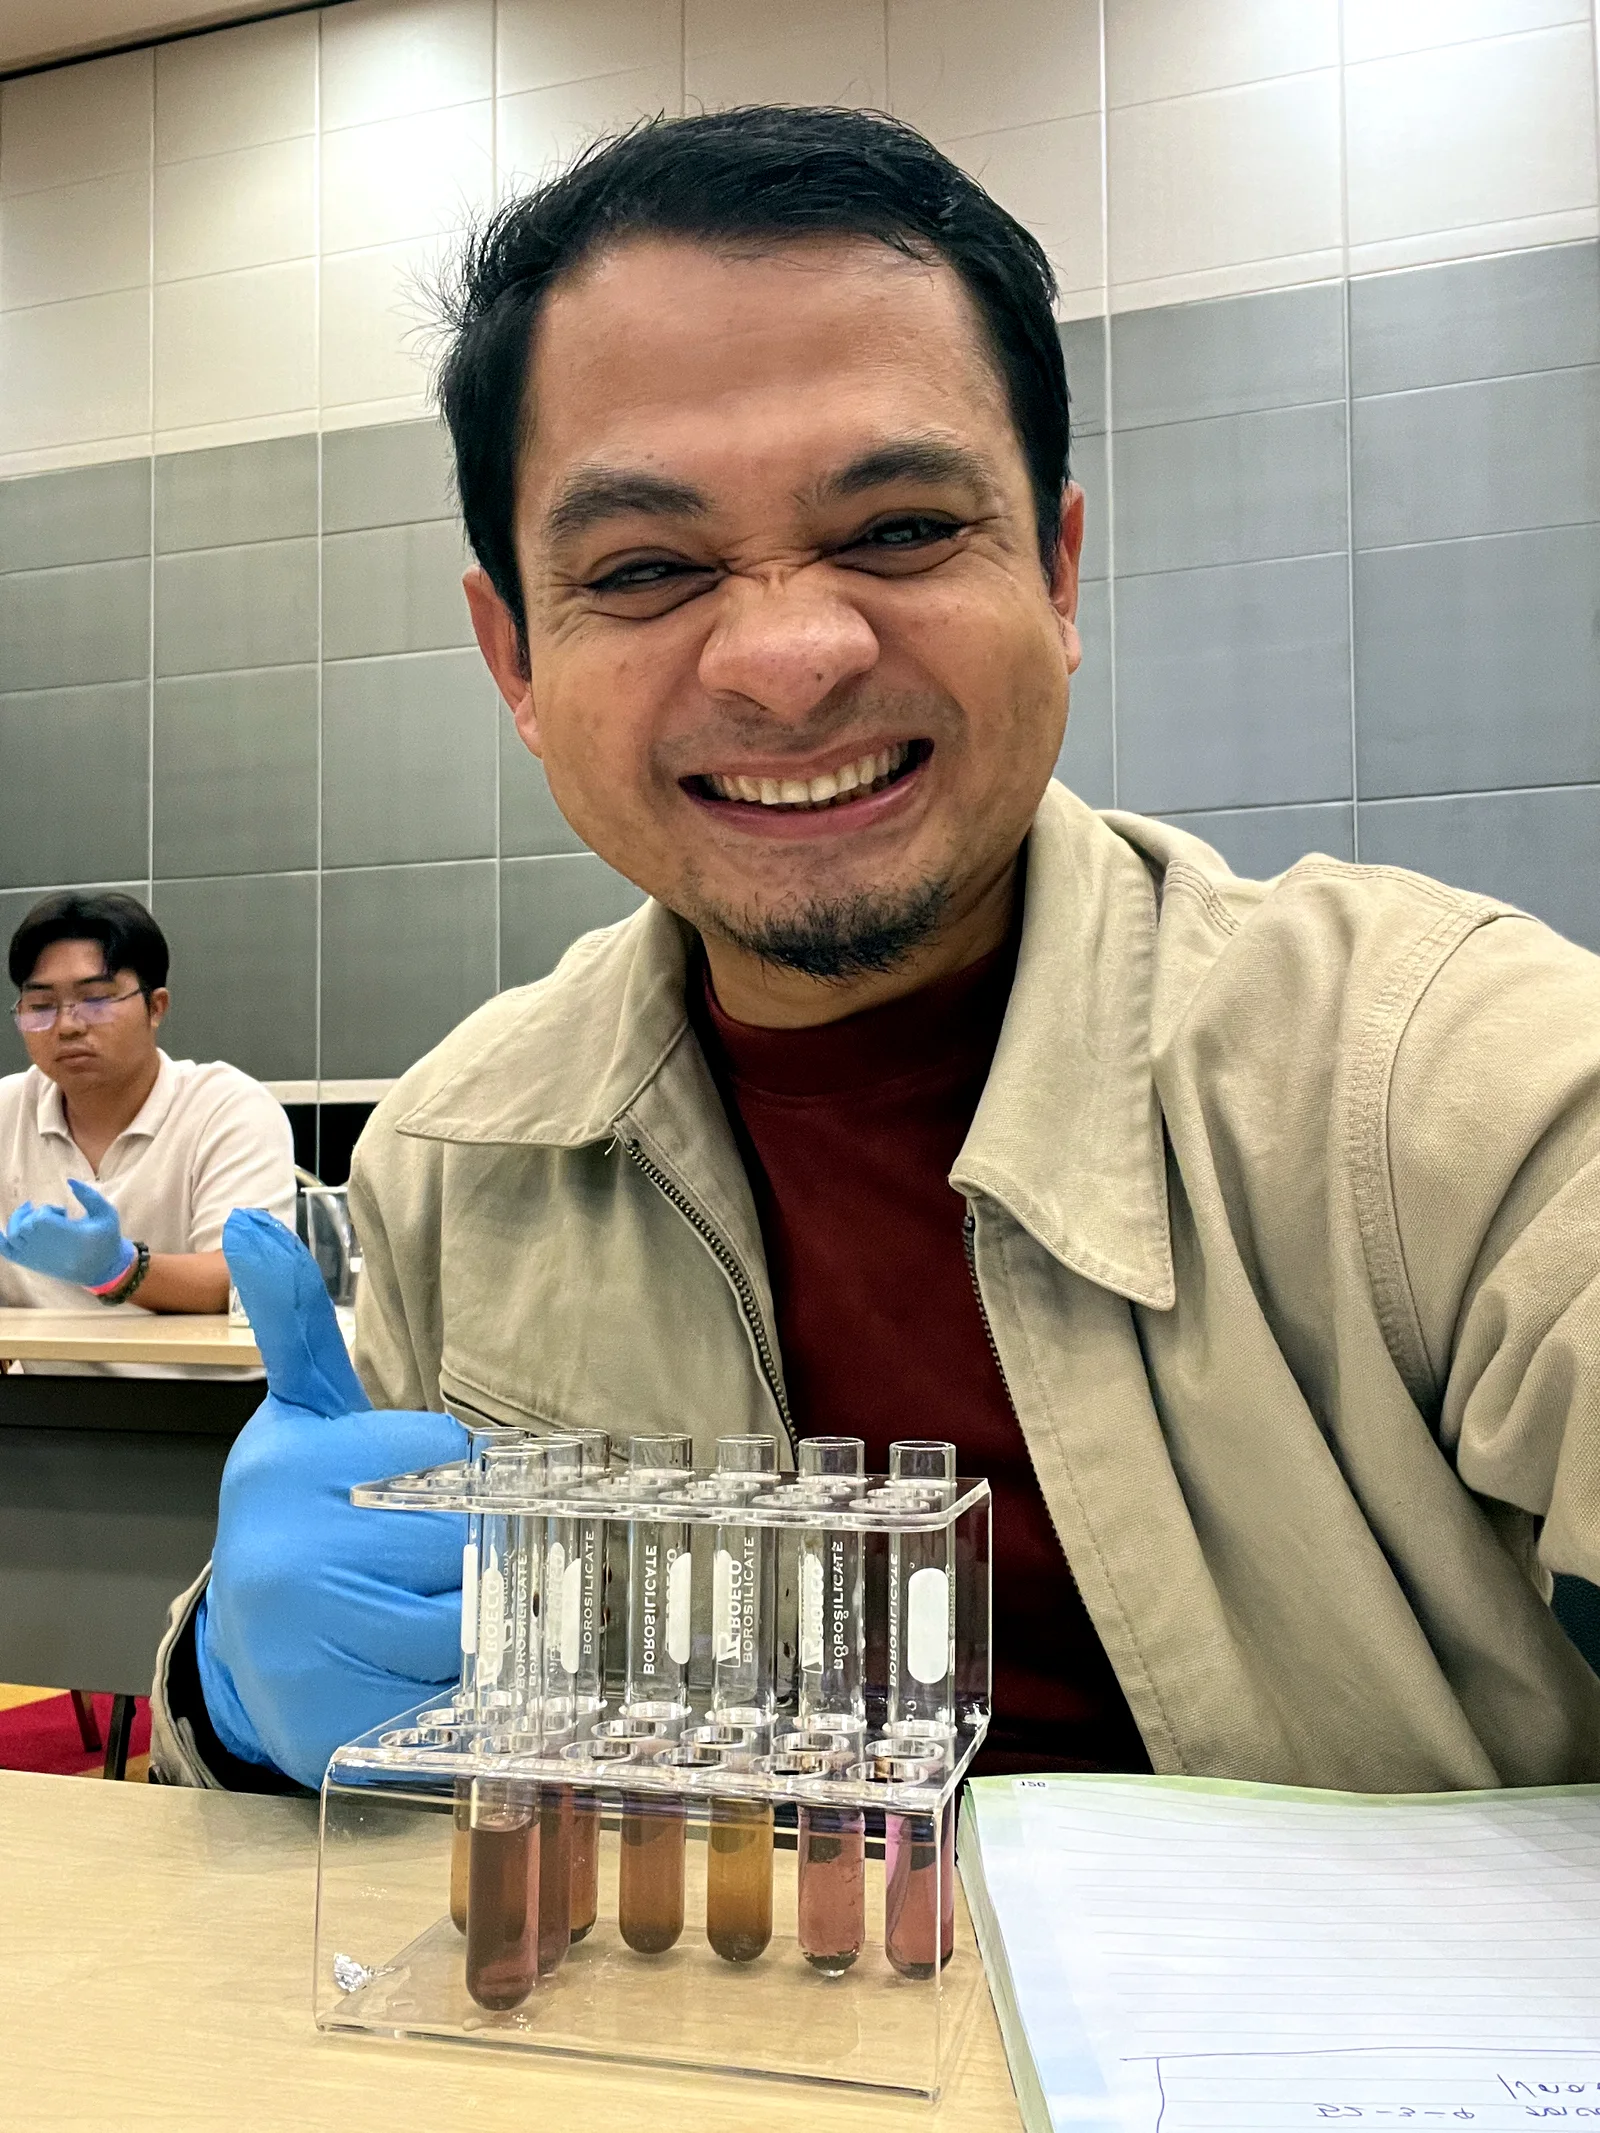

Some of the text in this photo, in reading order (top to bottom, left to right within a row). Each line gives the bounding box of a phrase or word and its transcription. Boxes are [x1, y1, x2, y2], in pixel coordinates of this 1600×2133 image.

[583, 1530, 595, 1655] BOROSILICATE
[727, 1560, 743, 1627] BOECO
[742, 1536, 755, 1664] BOROSILICATE
[832, 1541, 845, 1670] BOROSILICATE
